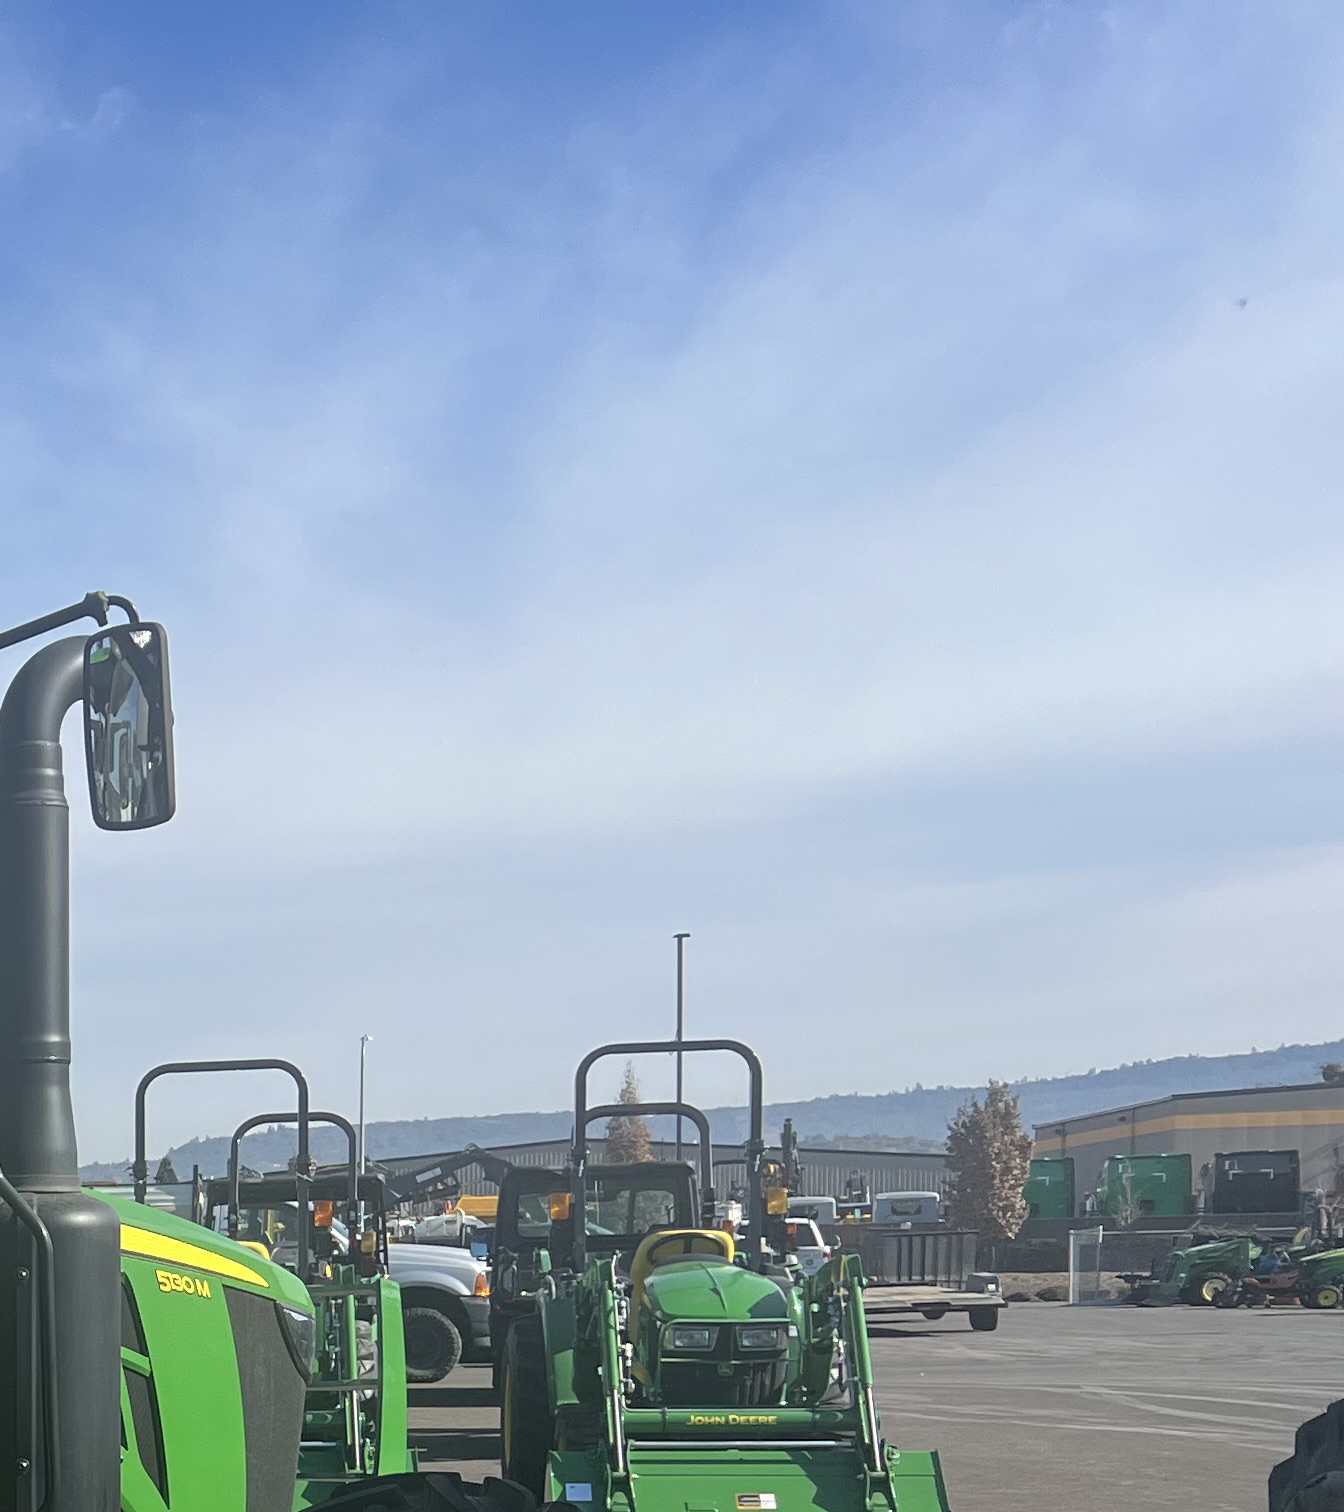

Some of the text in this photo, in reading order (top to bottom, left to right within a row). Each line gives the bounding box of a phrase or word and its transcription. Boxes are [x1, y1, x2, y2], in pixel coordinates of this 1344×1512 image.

[194, 1278, 212, 1299] M
[688, 1414, 778, 1425] JOHN DEERE
